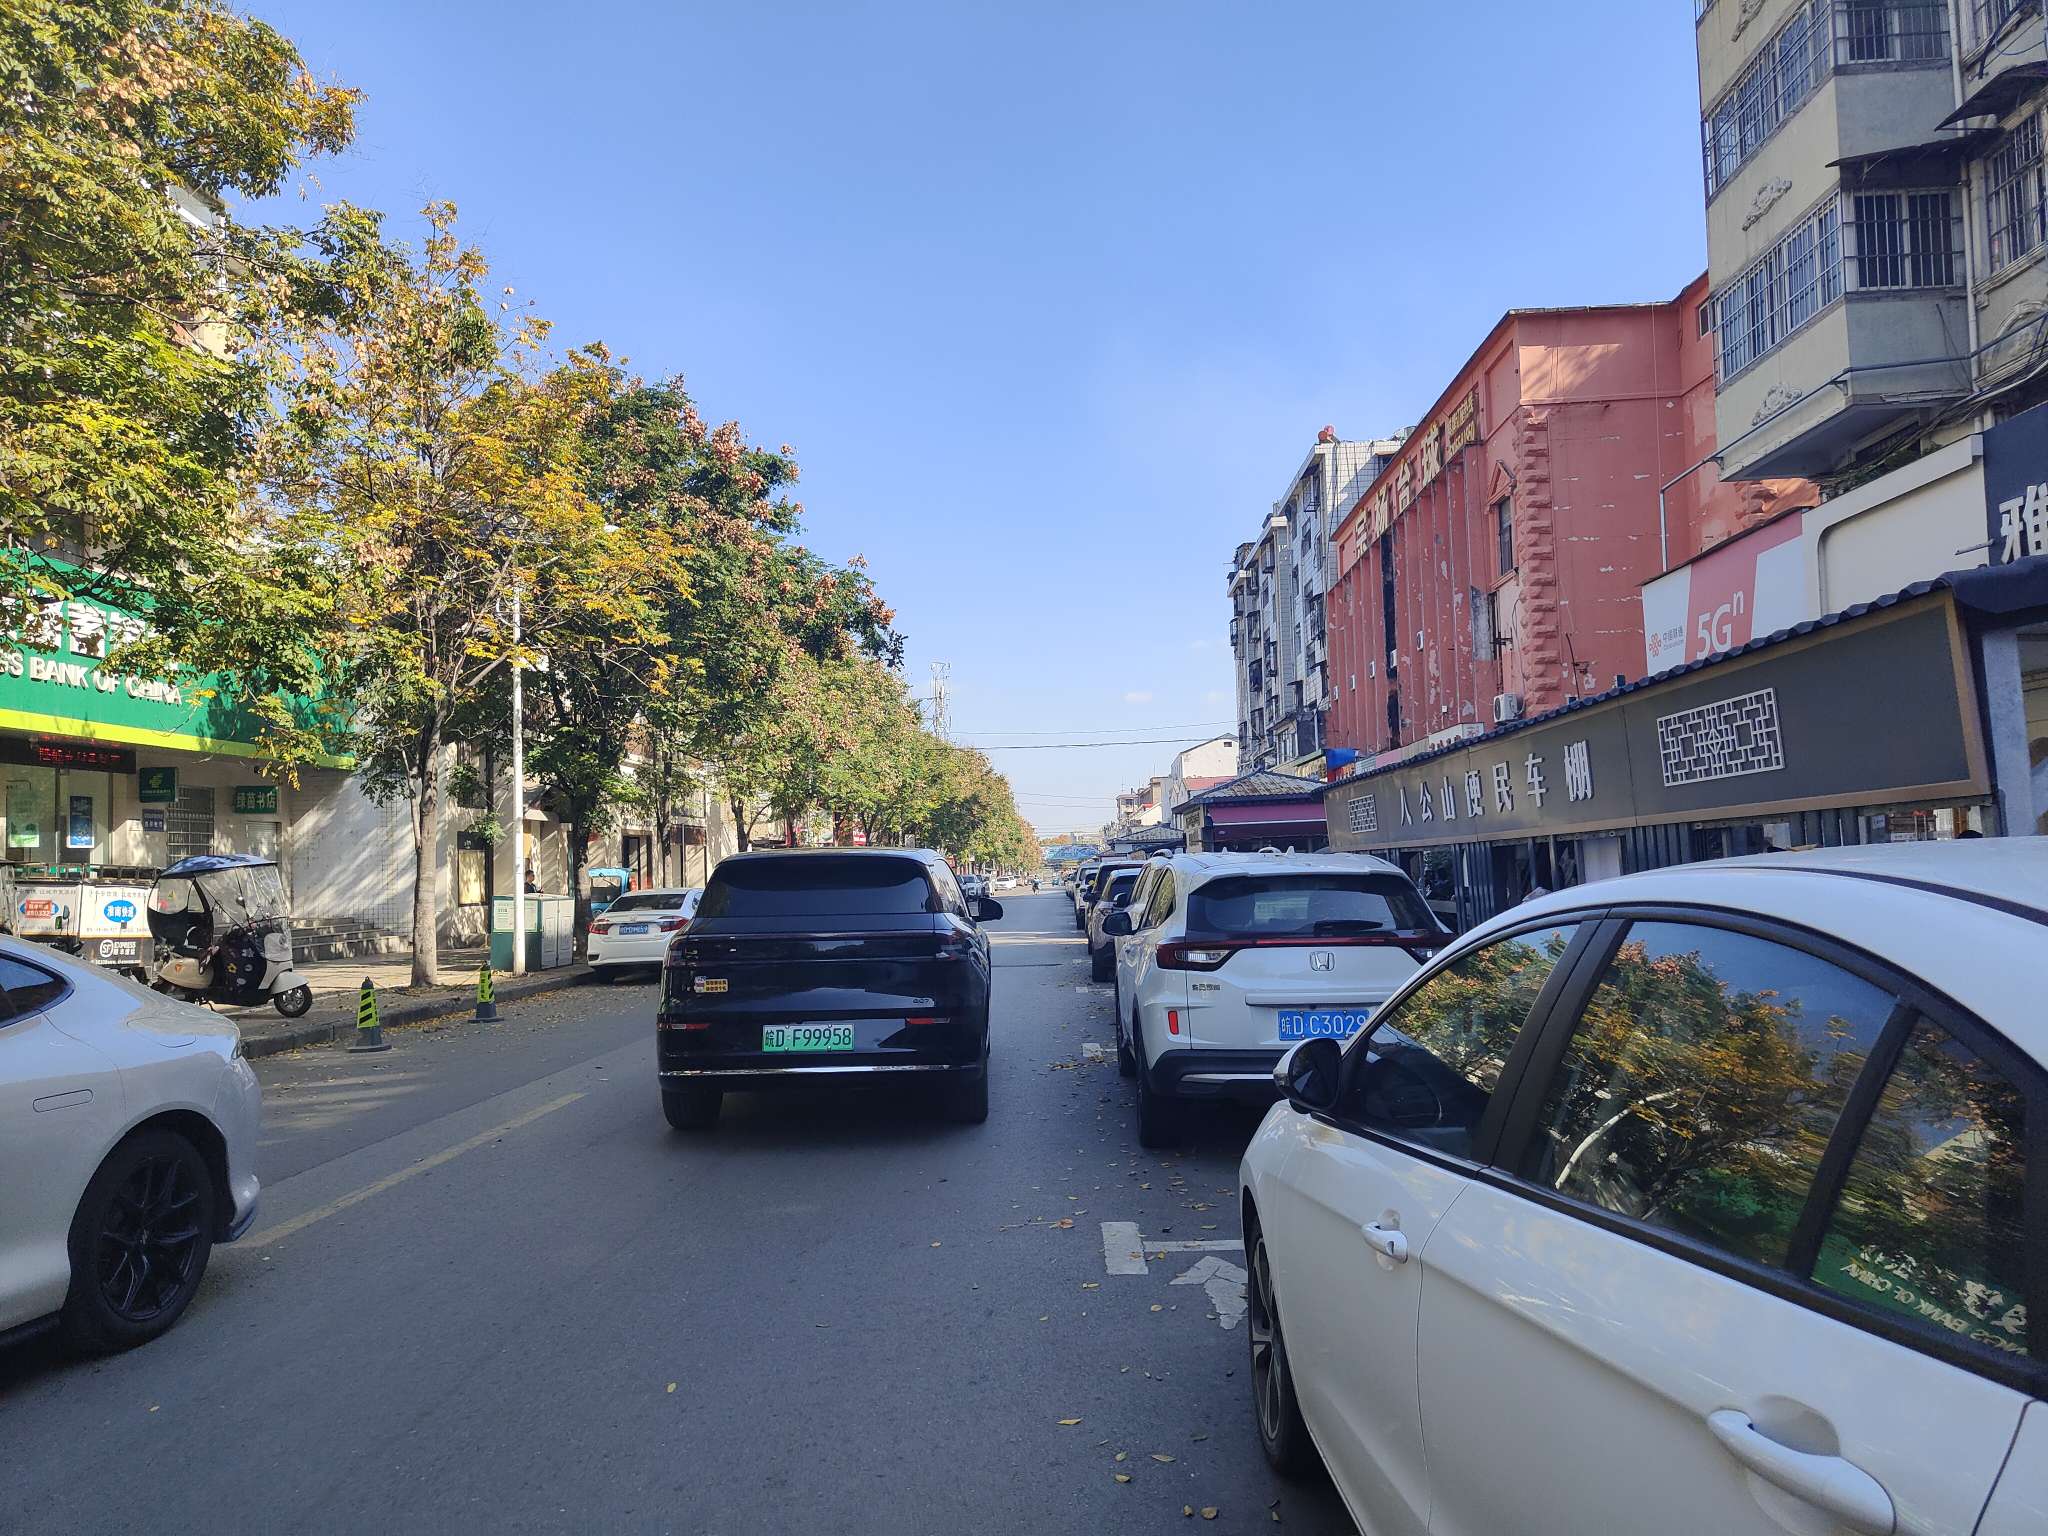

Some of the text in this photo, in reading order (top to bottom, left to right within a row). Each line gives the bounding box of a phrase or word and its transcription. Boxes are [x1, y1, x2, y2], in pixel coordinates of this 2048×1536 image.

[30, 656, 89, 689] BANK
[93, 667, 120, 693] OF
[126, 673, 182, 706] CHINA
